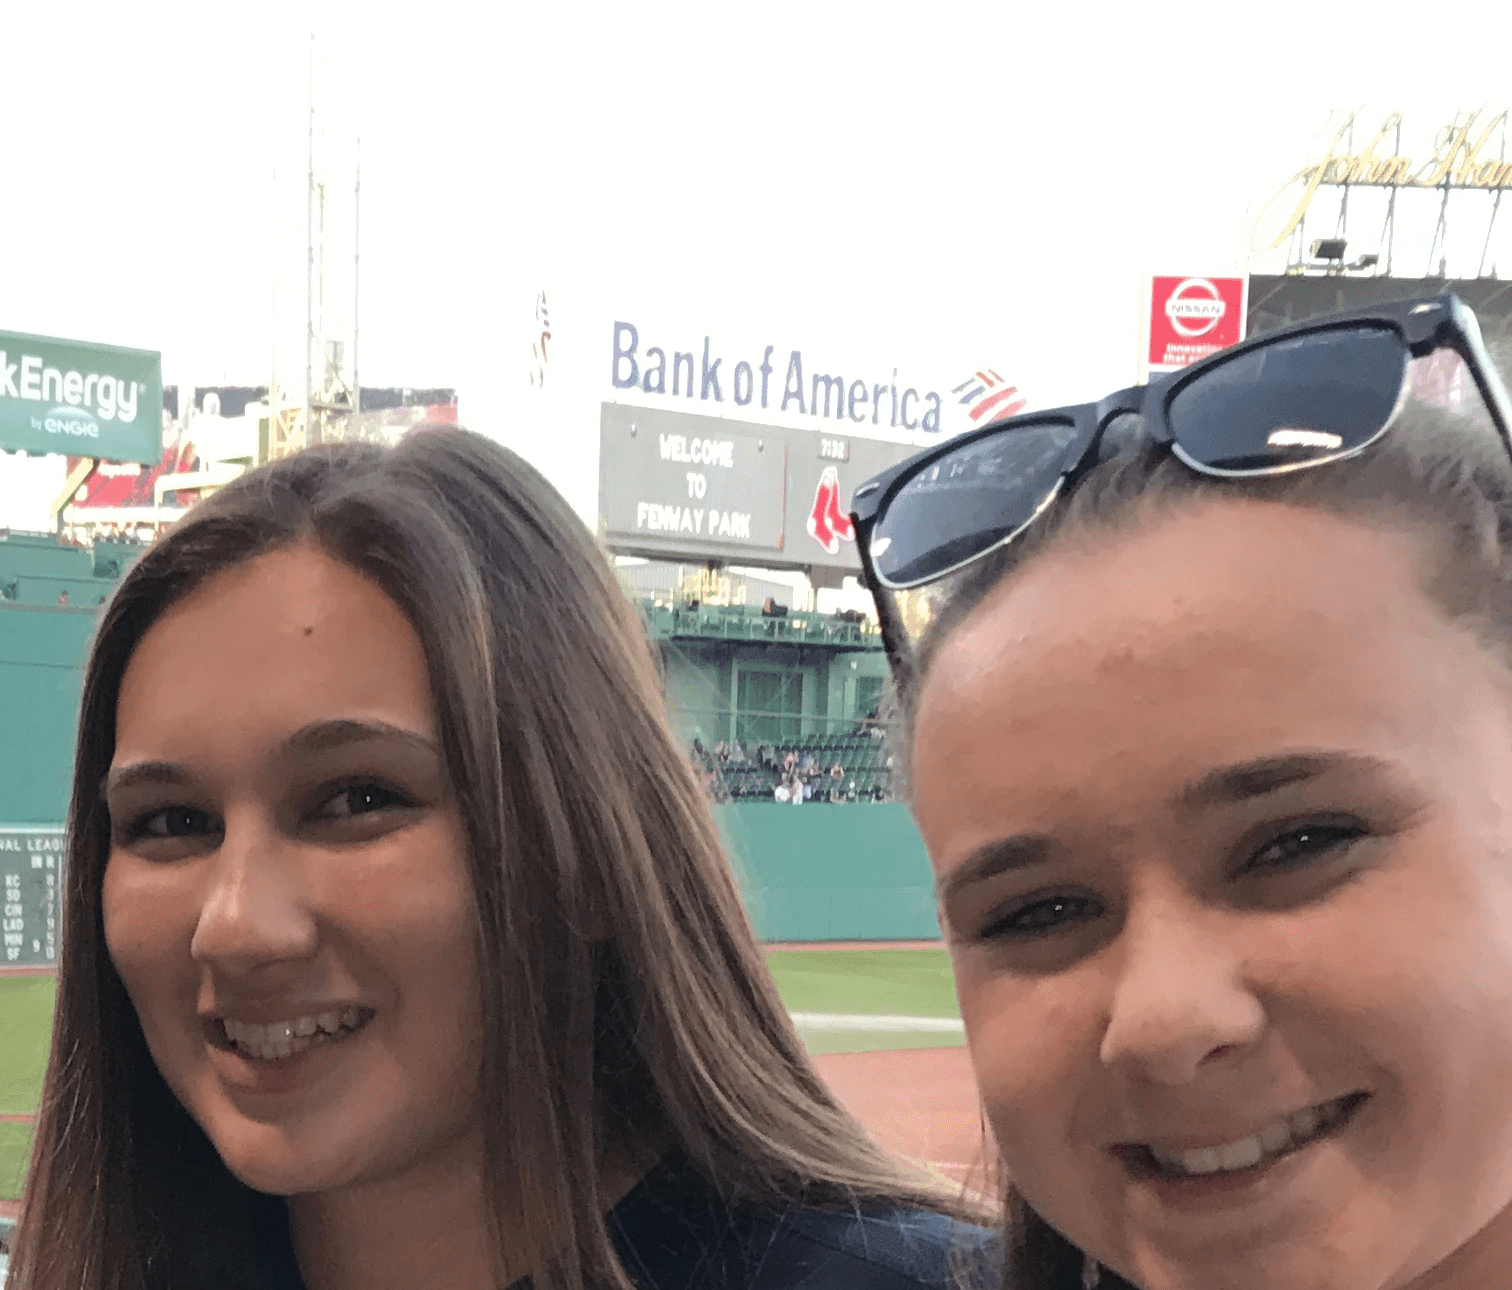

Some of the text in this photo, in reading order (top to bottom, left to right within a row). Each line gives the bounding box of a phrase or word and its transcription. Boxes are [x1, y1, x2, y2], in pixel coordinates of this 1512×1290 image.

[611, 320, 943, 433] Bank of America
[659, 433, 734, 468] WELCOME
[686, 472, 707, 500] TO
[637, 503, 751, 540] FENWAY PARK
